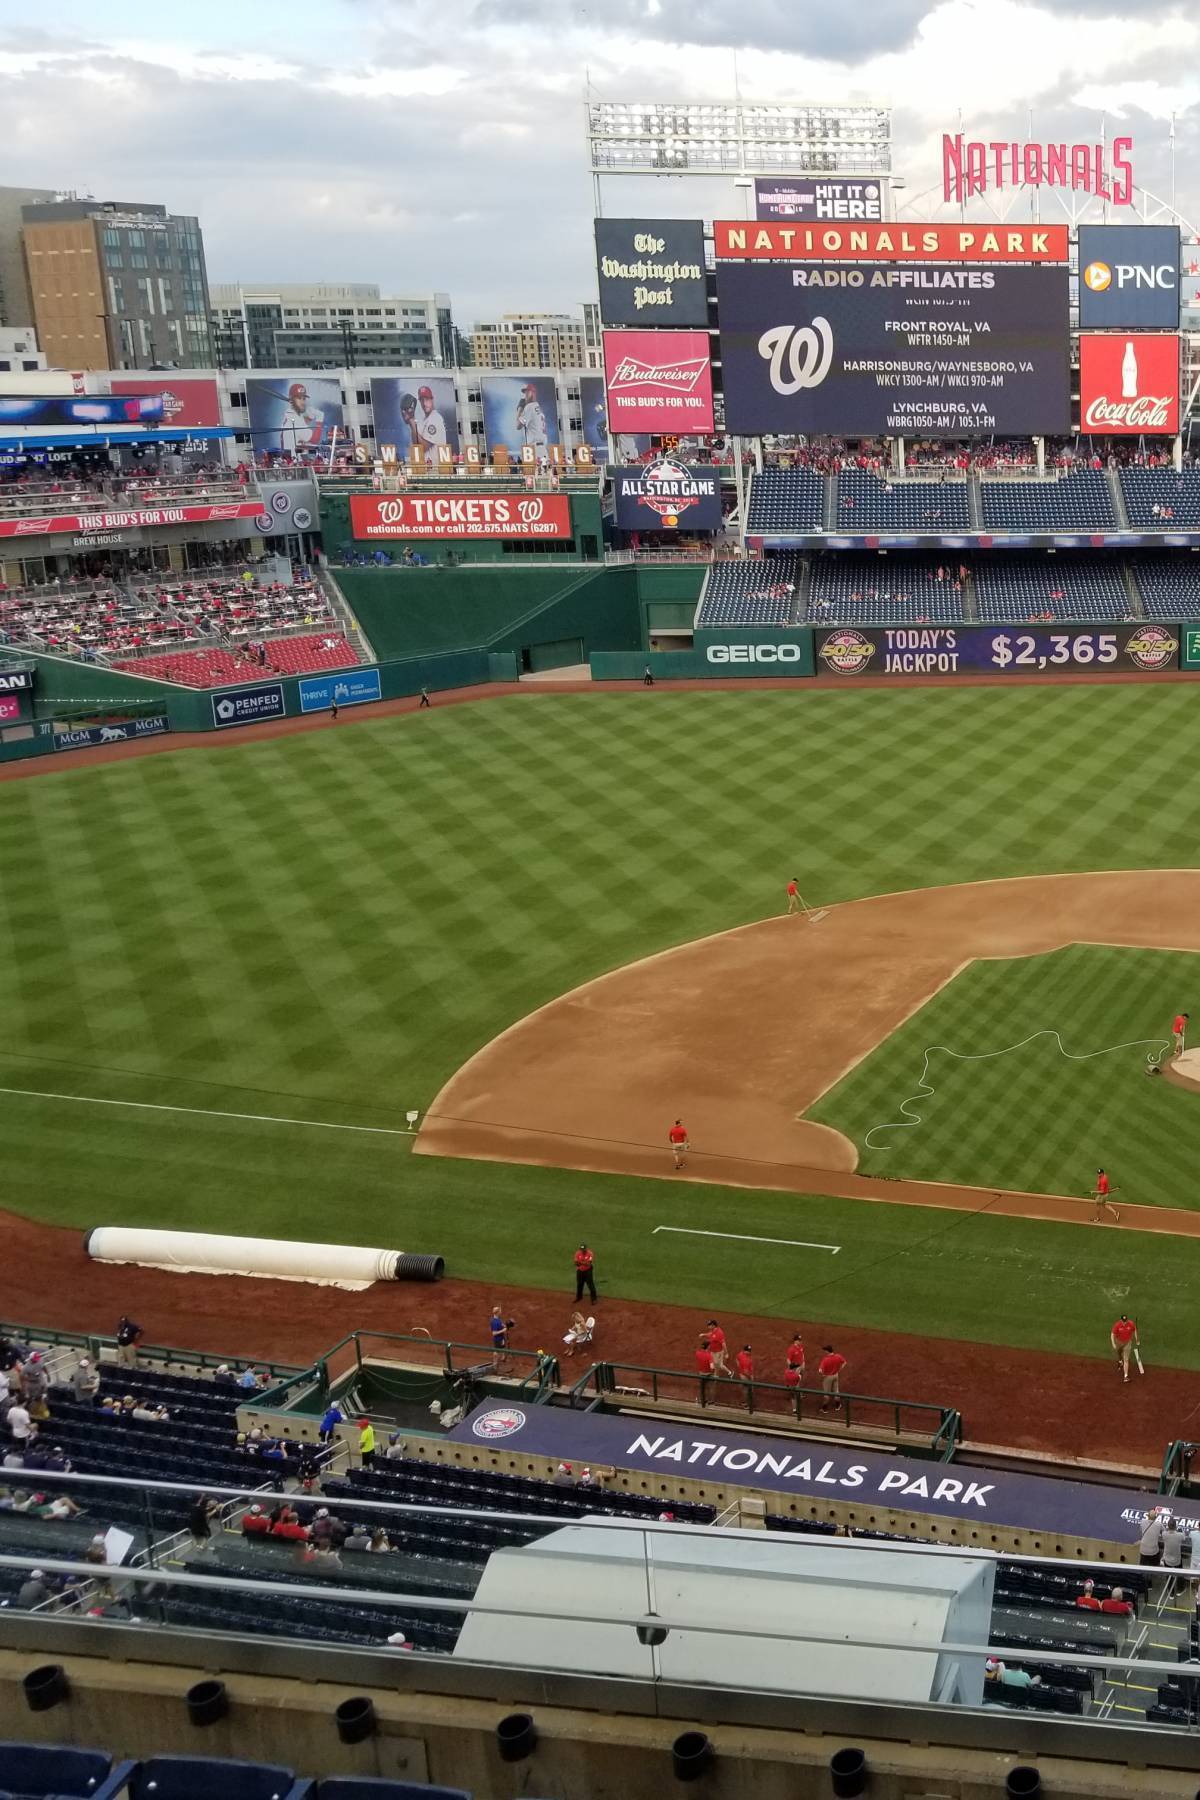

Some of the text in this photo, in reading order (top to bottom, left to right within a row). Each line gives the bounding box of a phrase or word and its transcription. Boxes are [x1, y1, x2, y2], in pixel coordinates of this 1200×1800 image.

[943, 134, 1133, 205] NATIONALS
[816, 185, 863, 198] HIT IT
[817, 200, 880, 218] HERE
[634, 234, 665, 255] The
[728, 229, 1050, 253] NATIONALS PARK
[601, 256, 702, 283] Washington
[1115, 265, 1174, 289] PNC
[793, 270, 995, 289] RADIO AFFILIATES
[634, 286, 673, 309] Post
[884, 321, 991, 334] FRONT ROYAL, VA
[907, 334, 970, 346] WFTR 1450-AM
[615, 363, 698, 381] Budweiser
[843, 361, 1034, 374] HARRISONBURG/WAYNESBORO, VA
[876, 374, 900, 386] WKCY
[902, 374, 939, 387] 1300-AM
[947, 375, 969, 387] WKCI
[971, 375, 1004, 387] 970-AM
[616, 397, 705, 408] THIS BUD'S FOR YOU.
[893, 403, 987, 415] LYNCHBURG, VA
[1086, 396, 1173, 428] Coca-Cola
[959, 416, 995, 427] 105.1-FM
[660, 436, 679, 448] 1:55
[681, 481, 715, 495] GAME
[78, 509, 187, 528] THIS BUD'S FOR YOU.
[411, 499, 510, 522] TICKETS
[367, 522, 558, 534] nationals.com or call 202.675.NATS (6287)
[73, 534, 123, 546] BREW HOUSE
[885, 630, 957, 649] TODAY'S
[1125, 639, 1178, 653] 50/50
[706, 644, 801, 663] GEICO
[820, 643, 875, 657] 50/50
[991, 633, 1118, 670] $2,365
[884, 653, 959, 673] JACKPOT
[236, 693, 279, 709] PENFED
[302, 689, 328, 701] THRIVE
[237, 703, 279, 716] CREDIT UNION
[60, 718, 164, 744] MGM MGM
[627, 1433, 996, 1508] NATIONALS PARK
